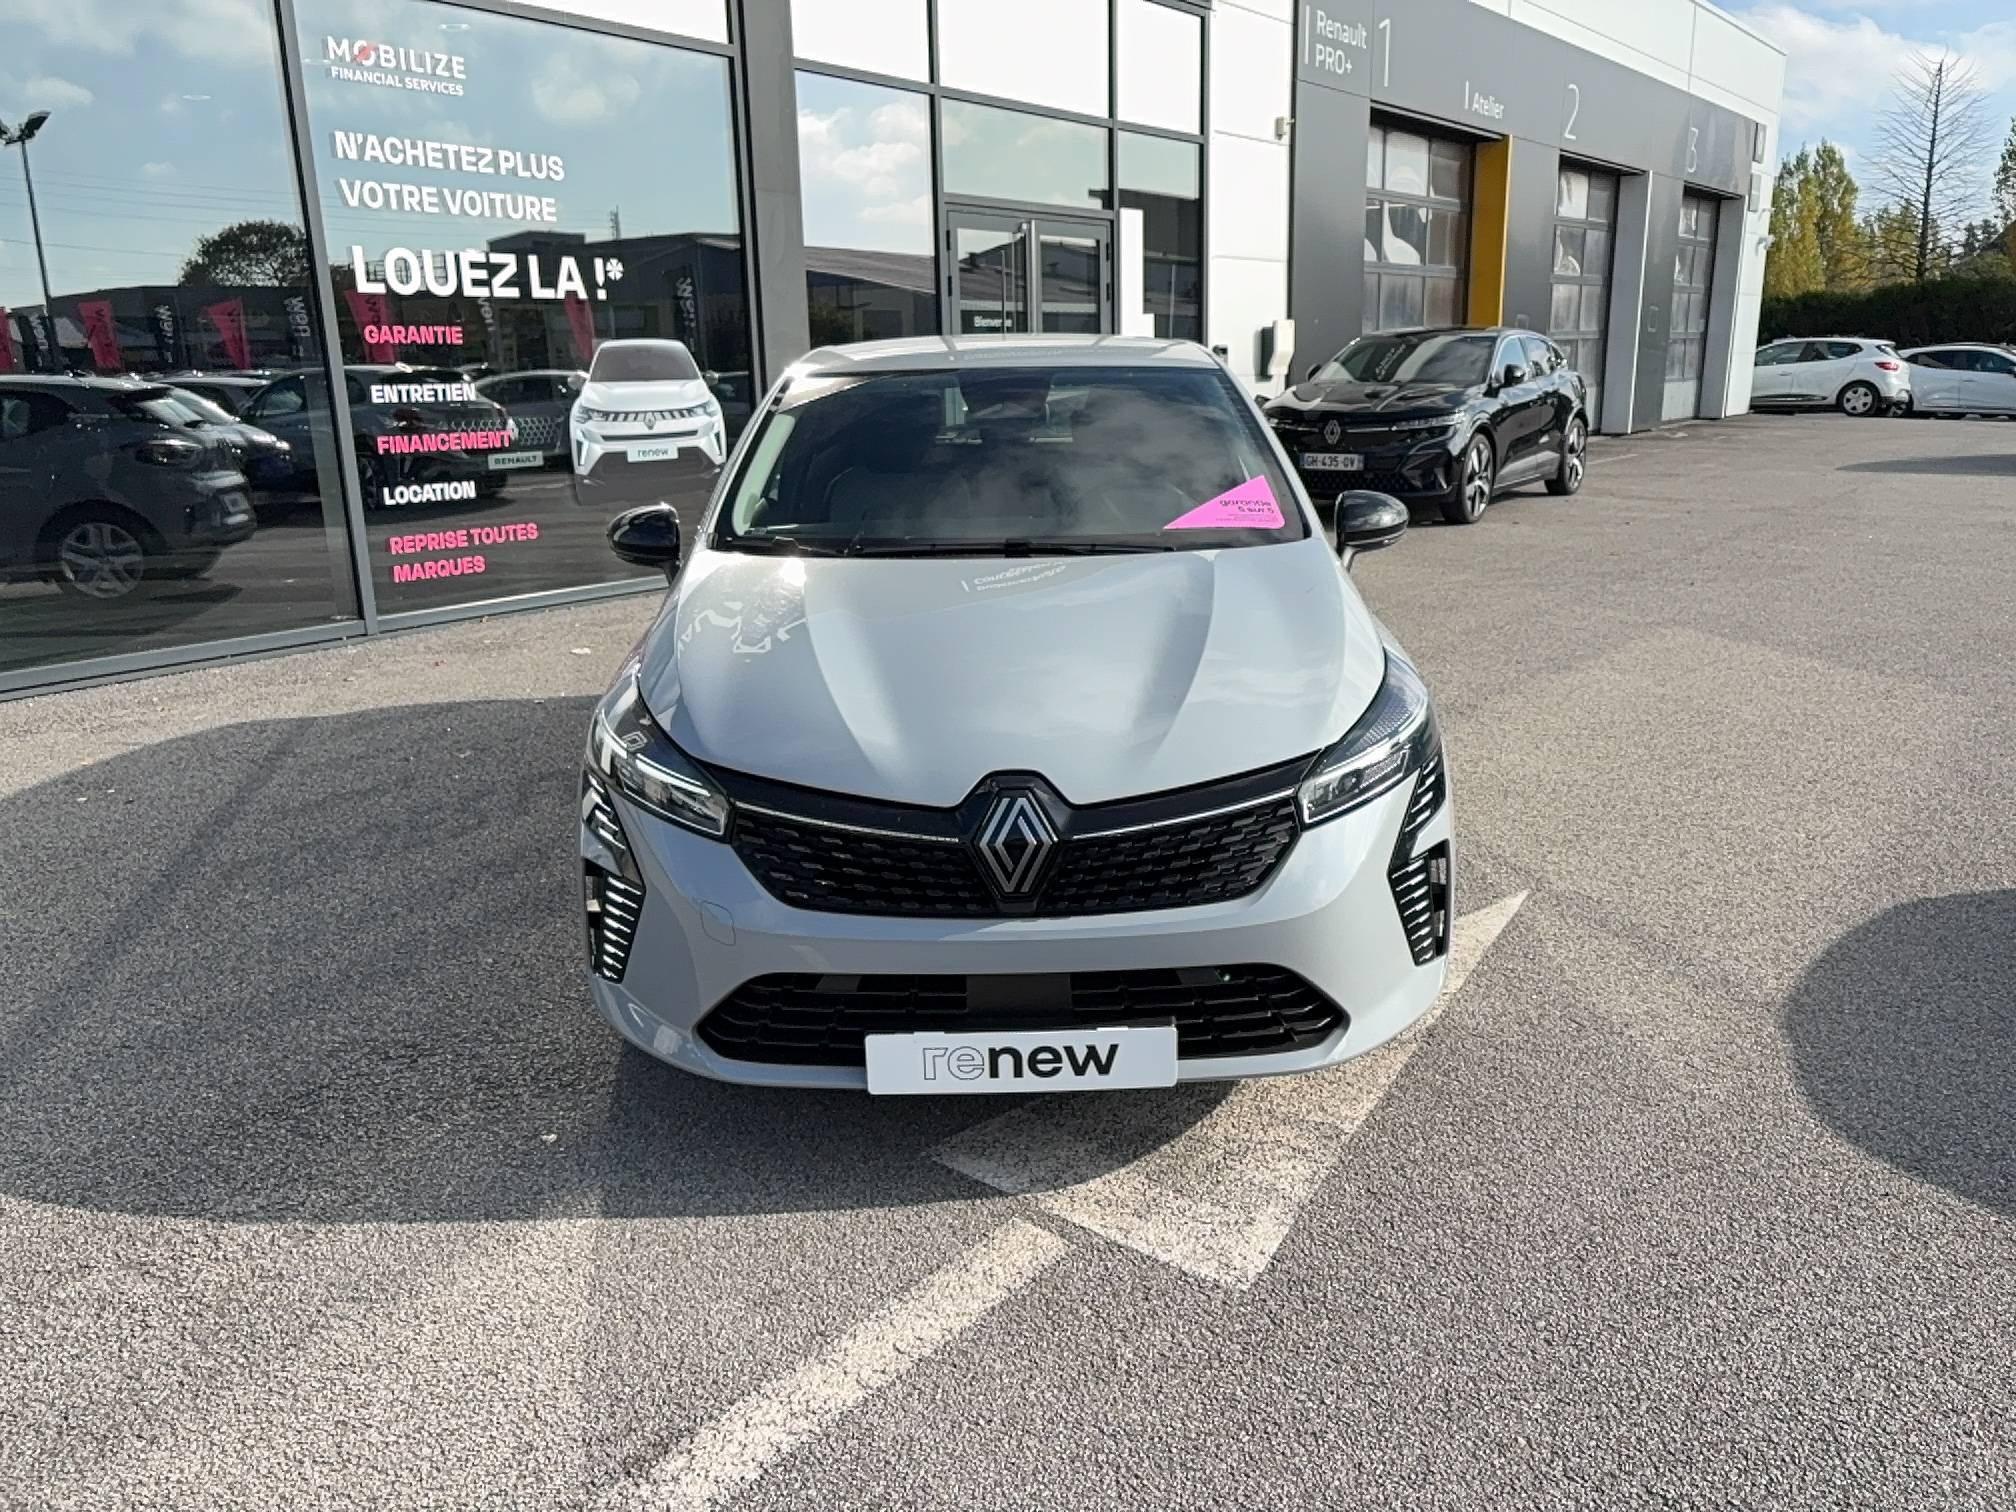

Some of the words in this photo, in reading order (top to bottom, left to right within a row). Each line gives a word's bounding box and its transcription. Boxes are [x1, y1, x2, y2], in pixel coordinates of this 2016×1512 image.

[1316, 10, 1367, 49] Renault
[327, 35, 467, 80] MOBILIZE
[1315, 43, 1352, 74] PRO+
[1379, 18, 1391, 87] 1
[331, 66, 403, 88] FINANCIAL
[404, 77, 465, 96] SERVICES
[1472, 91, 1505, 120] Atelier
[1564, 83, 1581, 140] 2
[334, 130, 494, 174] N'ACHETEZ
[499, 149, 565, 182] PLUS
[1687, 127, 1700, 173] 3
[339, 178, 440, 214] VOTRE
[444, 190, 557, 222] VOITURE
[351, 245, 520, 298] LOUEZ
[527, 254, 588, 299] LA
[364, 325, 464, 345] GARANTIE
[370, 383, 476, 404] ENTRETIEN
[377, 430, 512, 455] FINANCEMENT
[637, 448, 669, 458] renew
[494, 455, 537, 465] RENAULT
[383, 481, 476, 506] LOCATION
[389, 528, 468, 555] REPRISE
[471, 523, 539, 545] TOUTES
[393, 556, 486, 584] MARQUES
[922, 1043, 1120, 1081] renew
